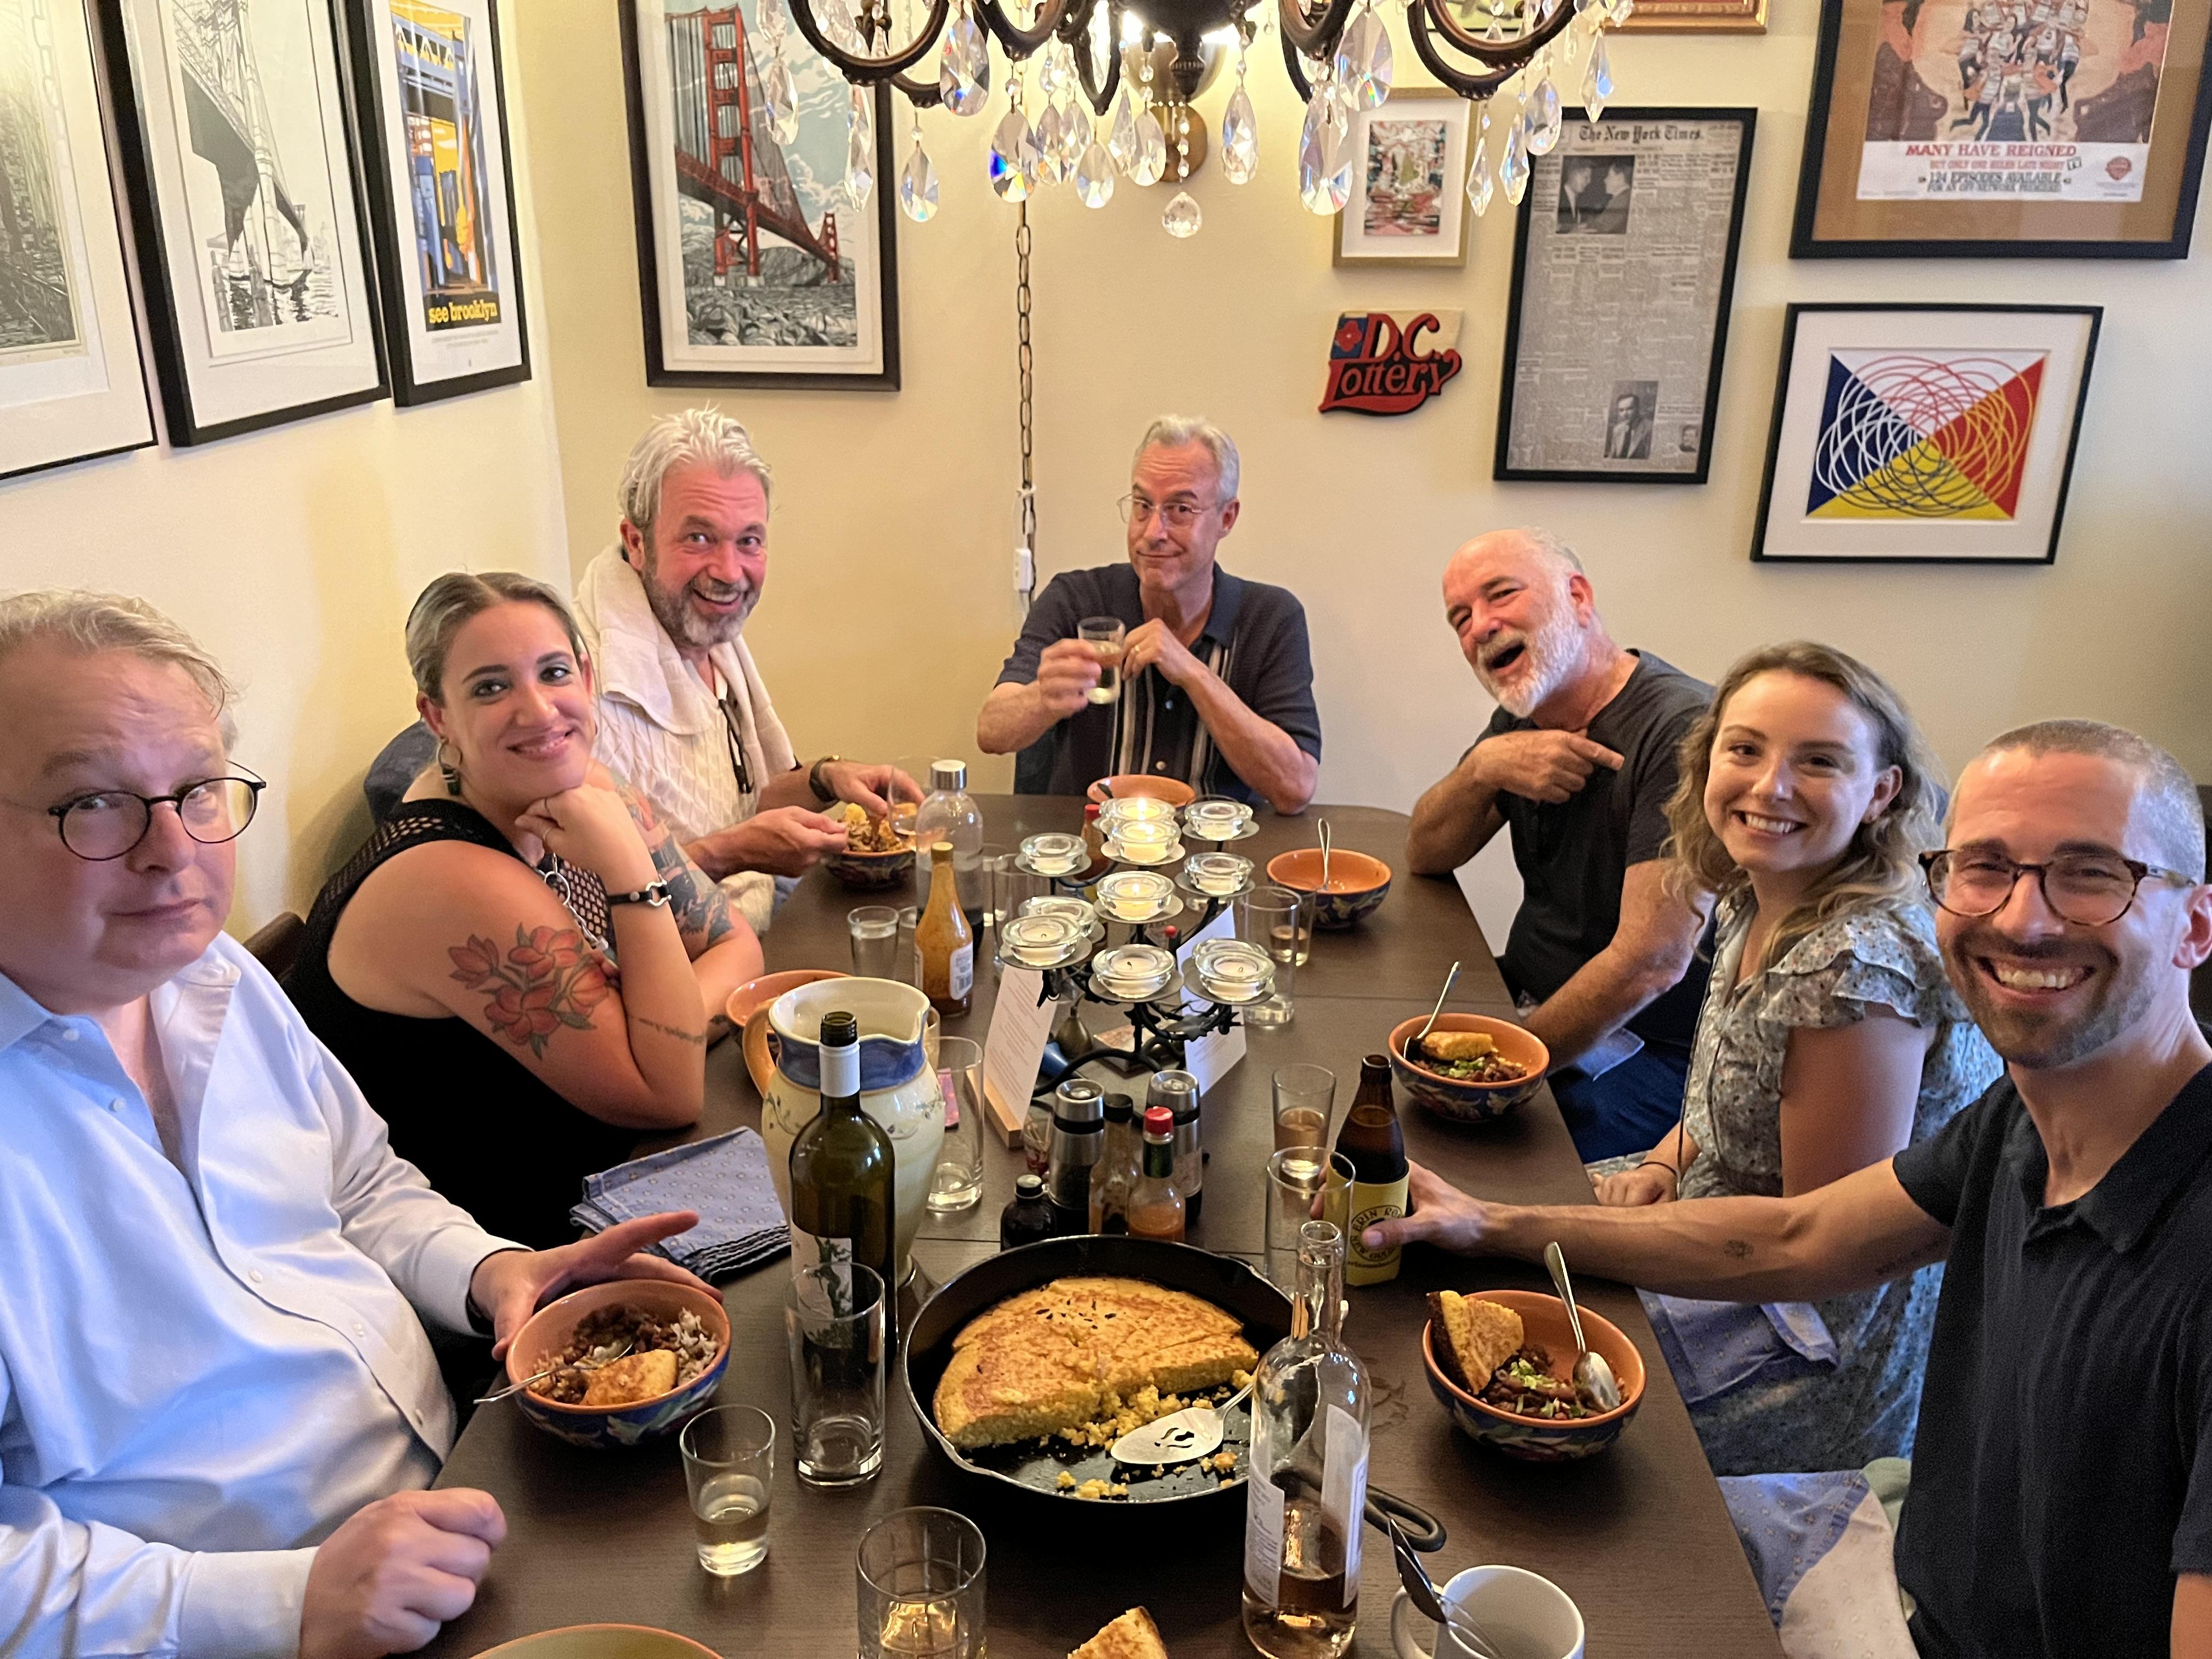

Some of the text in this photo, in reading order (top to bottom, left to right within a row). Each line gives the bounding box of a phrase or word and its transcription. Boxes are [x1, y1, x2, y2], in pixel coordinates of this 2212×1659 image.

[1579, 125, 1601, 142] The
[1604, 125, 1629, 140] New
[1633, 125, 1660, 144] York
[1905, 144, 2076, 157] MANY HAVE REIGNED
[1950, 172, 2002, 183] EPISODES
[2004, 172, 2062, 183] AVAILABLE
[428, 299, 498, 323] see brooklyn
[1359, 313, 1442, 362] D.C.
[1317, 348, 1463, 413] Lottery
[1352, 1209, 1377, 1232] ERIN
